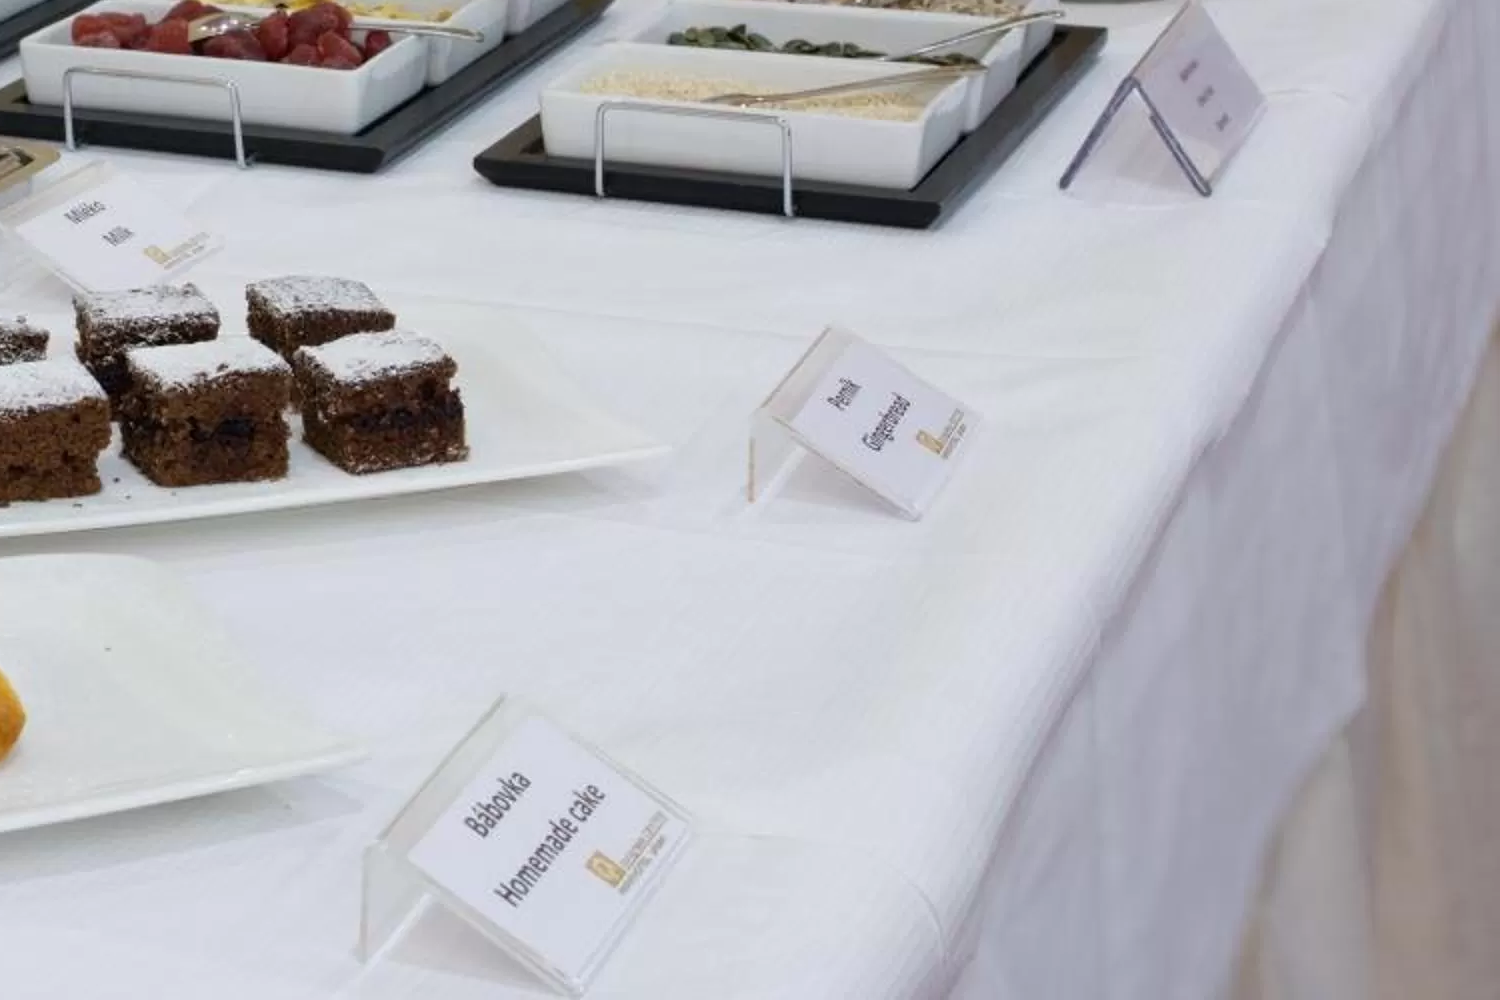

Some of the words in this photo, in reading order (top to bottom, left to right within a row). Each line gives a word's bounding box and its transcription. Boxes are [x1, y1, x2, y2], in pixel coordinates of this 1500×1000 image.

[861, 391, 912, 452] Gingerbread
[463, 771, 532, 839] Bábovka
[493, 818, 580, 908] Homemade
[568, 783, 607, 823] cake
